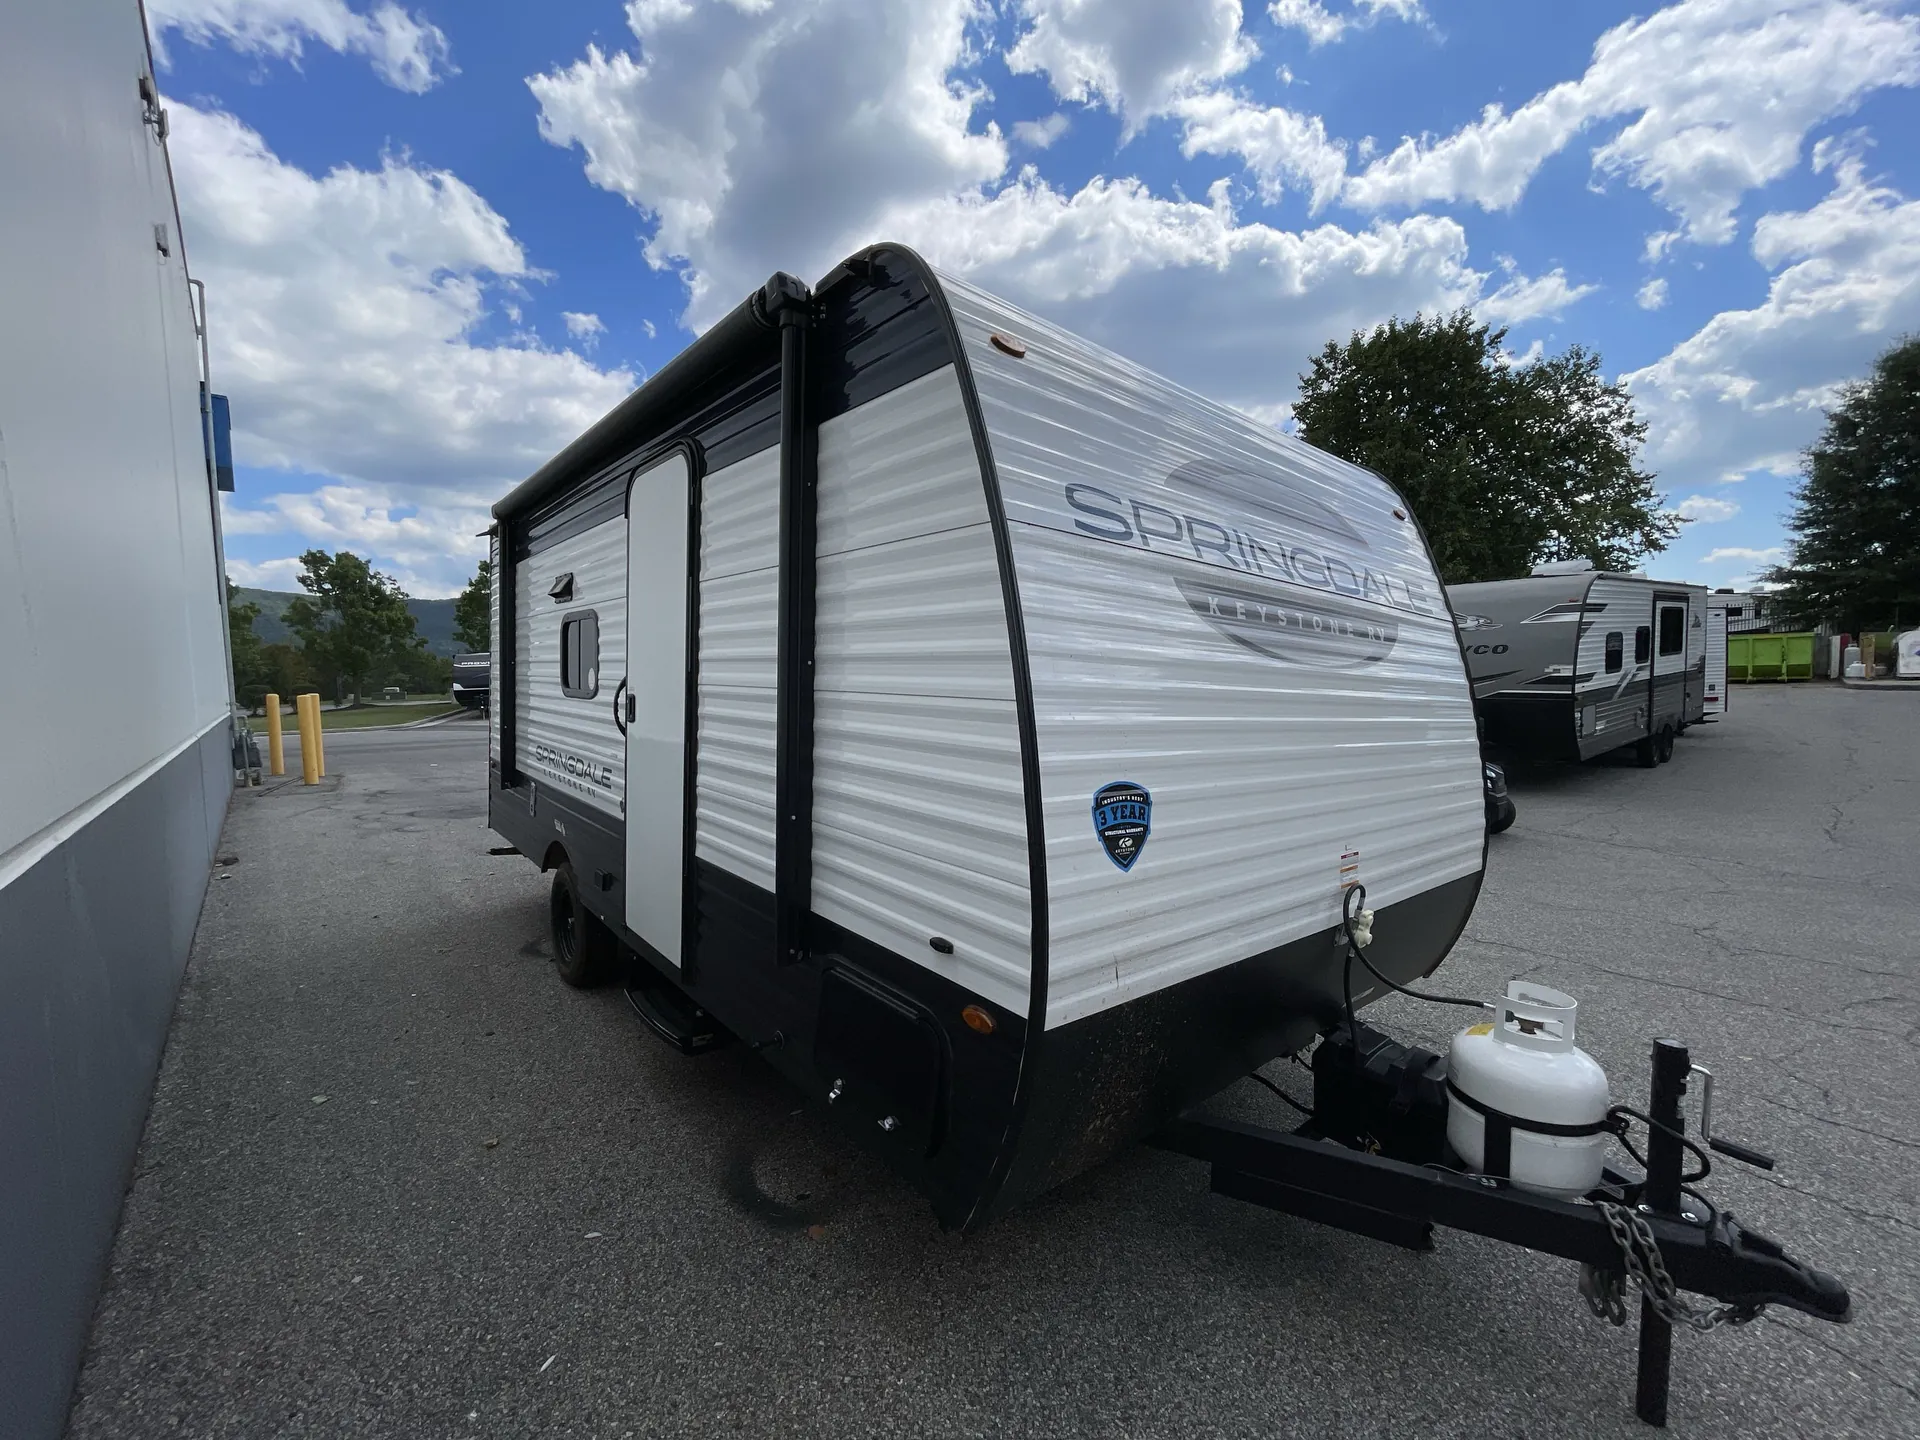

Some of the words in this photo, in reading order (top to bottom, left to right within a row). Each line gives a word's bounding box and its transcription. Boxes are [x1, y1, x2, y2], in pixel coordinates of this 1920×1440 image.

[1065, 482, 1434, 615] SPRINGDALE
[1207, 596, 1354, 637] KEYSTONE
[1366, 626, 1385, 643] RV
[535, 745, 613, 789] SPRINGDALE
[1098, 810, 1107, 826] 3
[1110, 804, 1146, 822] YEAR
